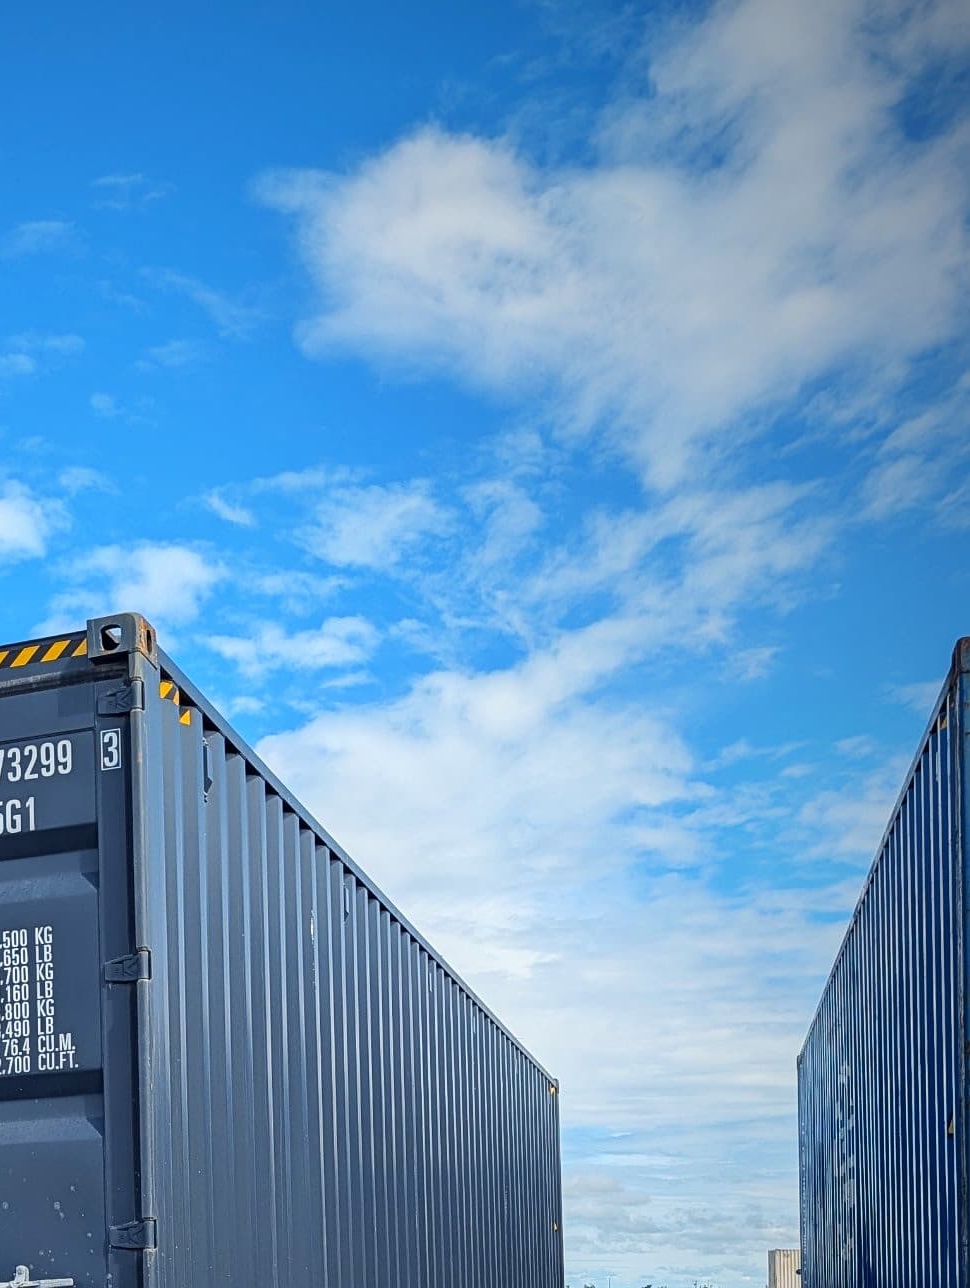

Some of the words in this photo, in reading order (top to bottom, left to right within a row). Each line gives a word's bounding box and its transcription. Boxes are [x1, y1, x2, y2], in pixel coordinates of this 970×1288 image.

[103, 732, 118, 767] 3
[34, 925, 53, 945] KG
[35, 944, 52, 963] LB
[36, 962, 54, 981] KG
[36, 980, 53, 999] LB
[37, 998, 55, 1017] KG
[37, 1016, 54, 1035] LB
[2, 1037, 31, 1057] 76.4
[37, 1032, 76, 1053] CU.M.
[37, 1050, 79, 1071] CU.FT.
